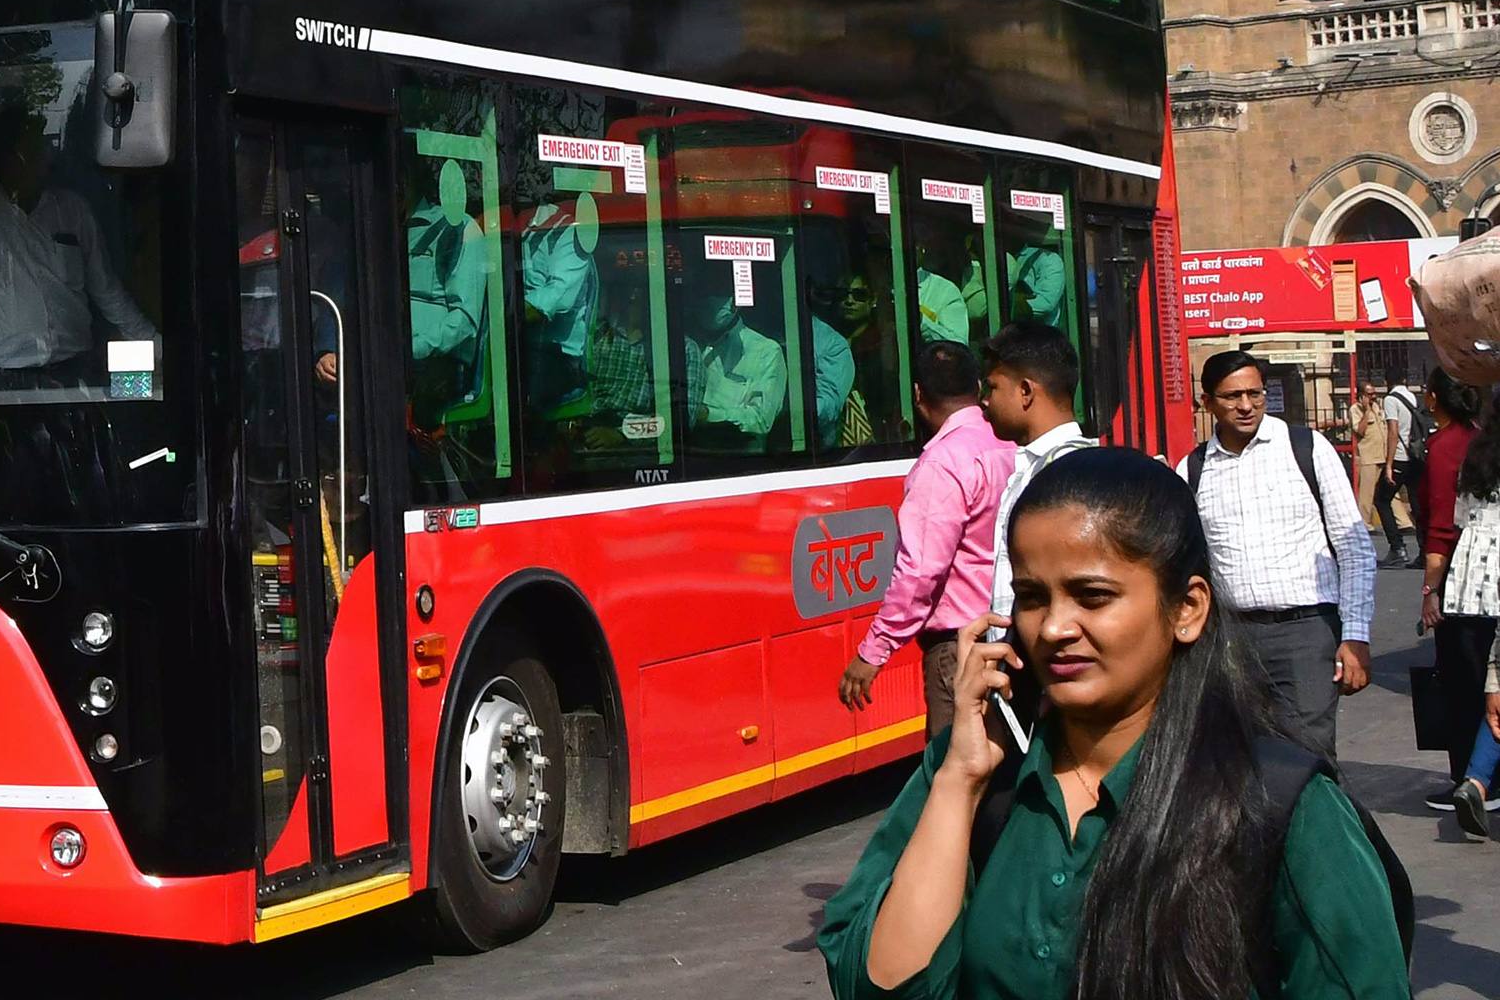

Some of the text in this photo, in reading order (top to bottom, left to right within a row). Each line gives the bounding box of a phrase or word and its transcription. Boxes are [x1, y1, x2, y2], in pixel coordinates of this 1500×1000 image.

[295, 17, 355, 49] SWITCH
[543, 140, 621, 162] EMERGENCY EXIT
[819, 170, 873, 190] EMERGENCY EXIT
[925, 183, 970, 200] EMERGENCY EXIT
[708, 240, 771, 257] EMERGENCY EXIT
[1201, 256, 1223, 270] कार्ड
[1184, 291, 1264, 304] BEST Chalo App
[807, 517, 885, 602] बेस्ट
